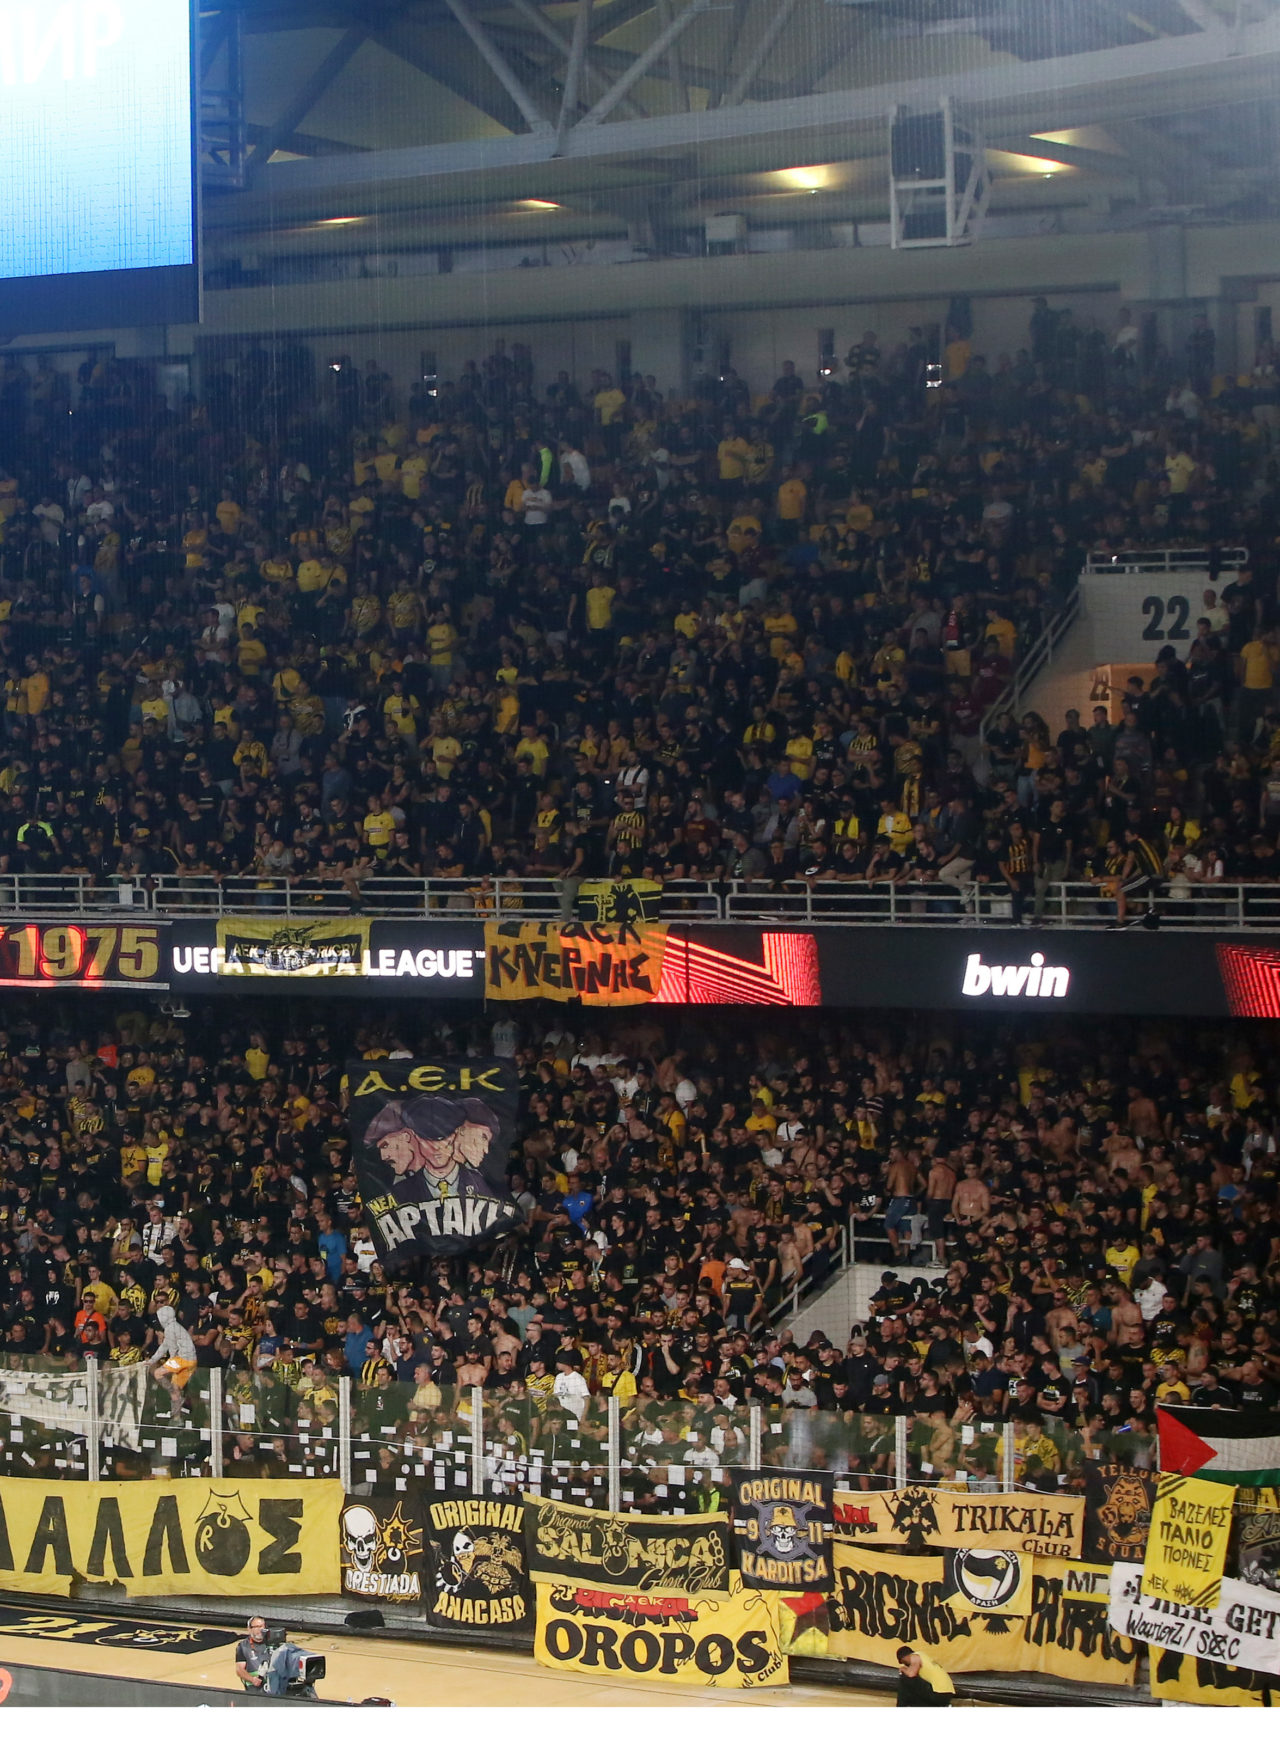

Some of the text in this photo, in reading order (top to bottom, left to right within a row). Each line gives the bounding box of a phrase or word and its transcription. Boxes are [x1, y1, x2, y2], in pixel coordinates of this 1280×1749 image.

[1142, 596, 1190, 640] 22
[8, 925, 160, 979] 1975
[961, 951, 1070, 998] bwin
[740, 1478, 826, 1509] ORIGINAL
[429, 1500, 524, 1533] ORIGINAL
[537, 1502, 592, 1531] Original
[952, 1504, 1074, 1539] TRIKALA
[1021, 1538, 1073, 1557] CLUB
[1096, 1537, 1144, 1558] SQUA
[1160, 1521, 1213, 1548] ΠΑΛΙΟ
[741, 1551, 829, 1584] KARDITSA
[1163, 1545, 1213, 1573] ΠΟΡΝΕΣ
[345, 1569, 420, 1594] ORESTIADA
[637, 1566, 727, 1594] Ghost Club
[433, 1591, 526, 1624] ANACASA
[545, 1619, 782, 1682] OROPOS Club
